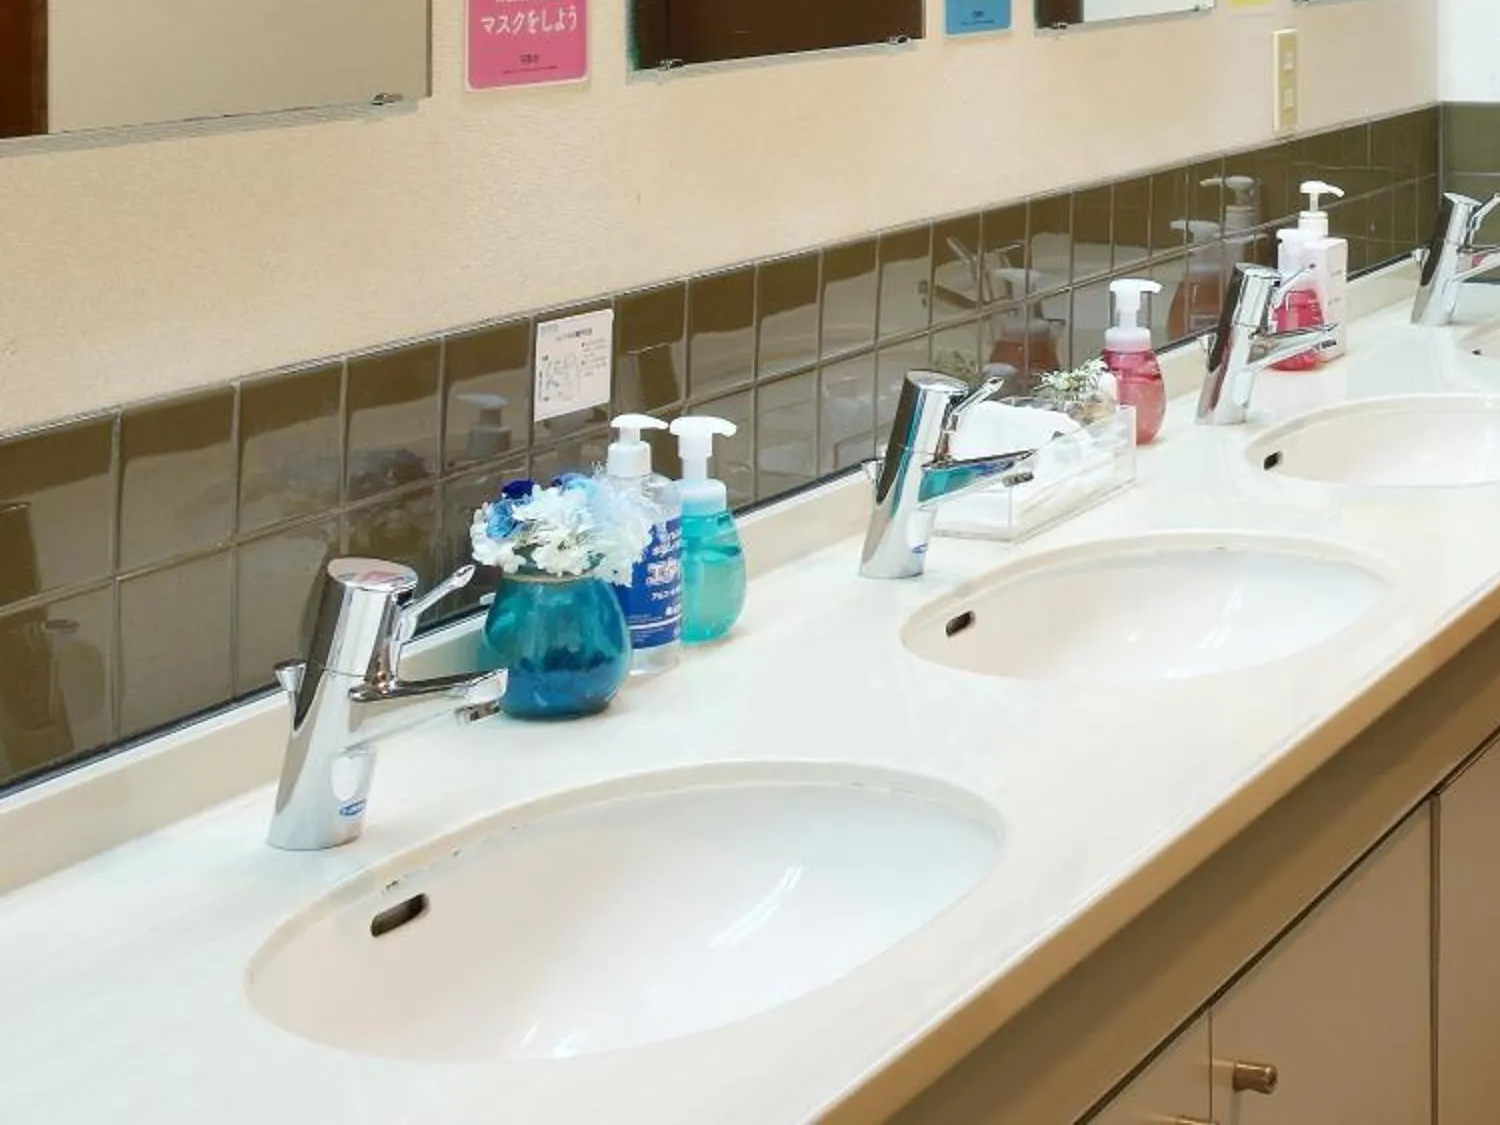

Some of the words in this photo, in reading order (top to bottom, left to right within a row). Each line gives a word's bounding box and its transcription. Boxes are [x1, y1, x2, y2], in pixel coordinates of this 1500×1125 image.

[480, 5, 577, 34] マスクをしよう
